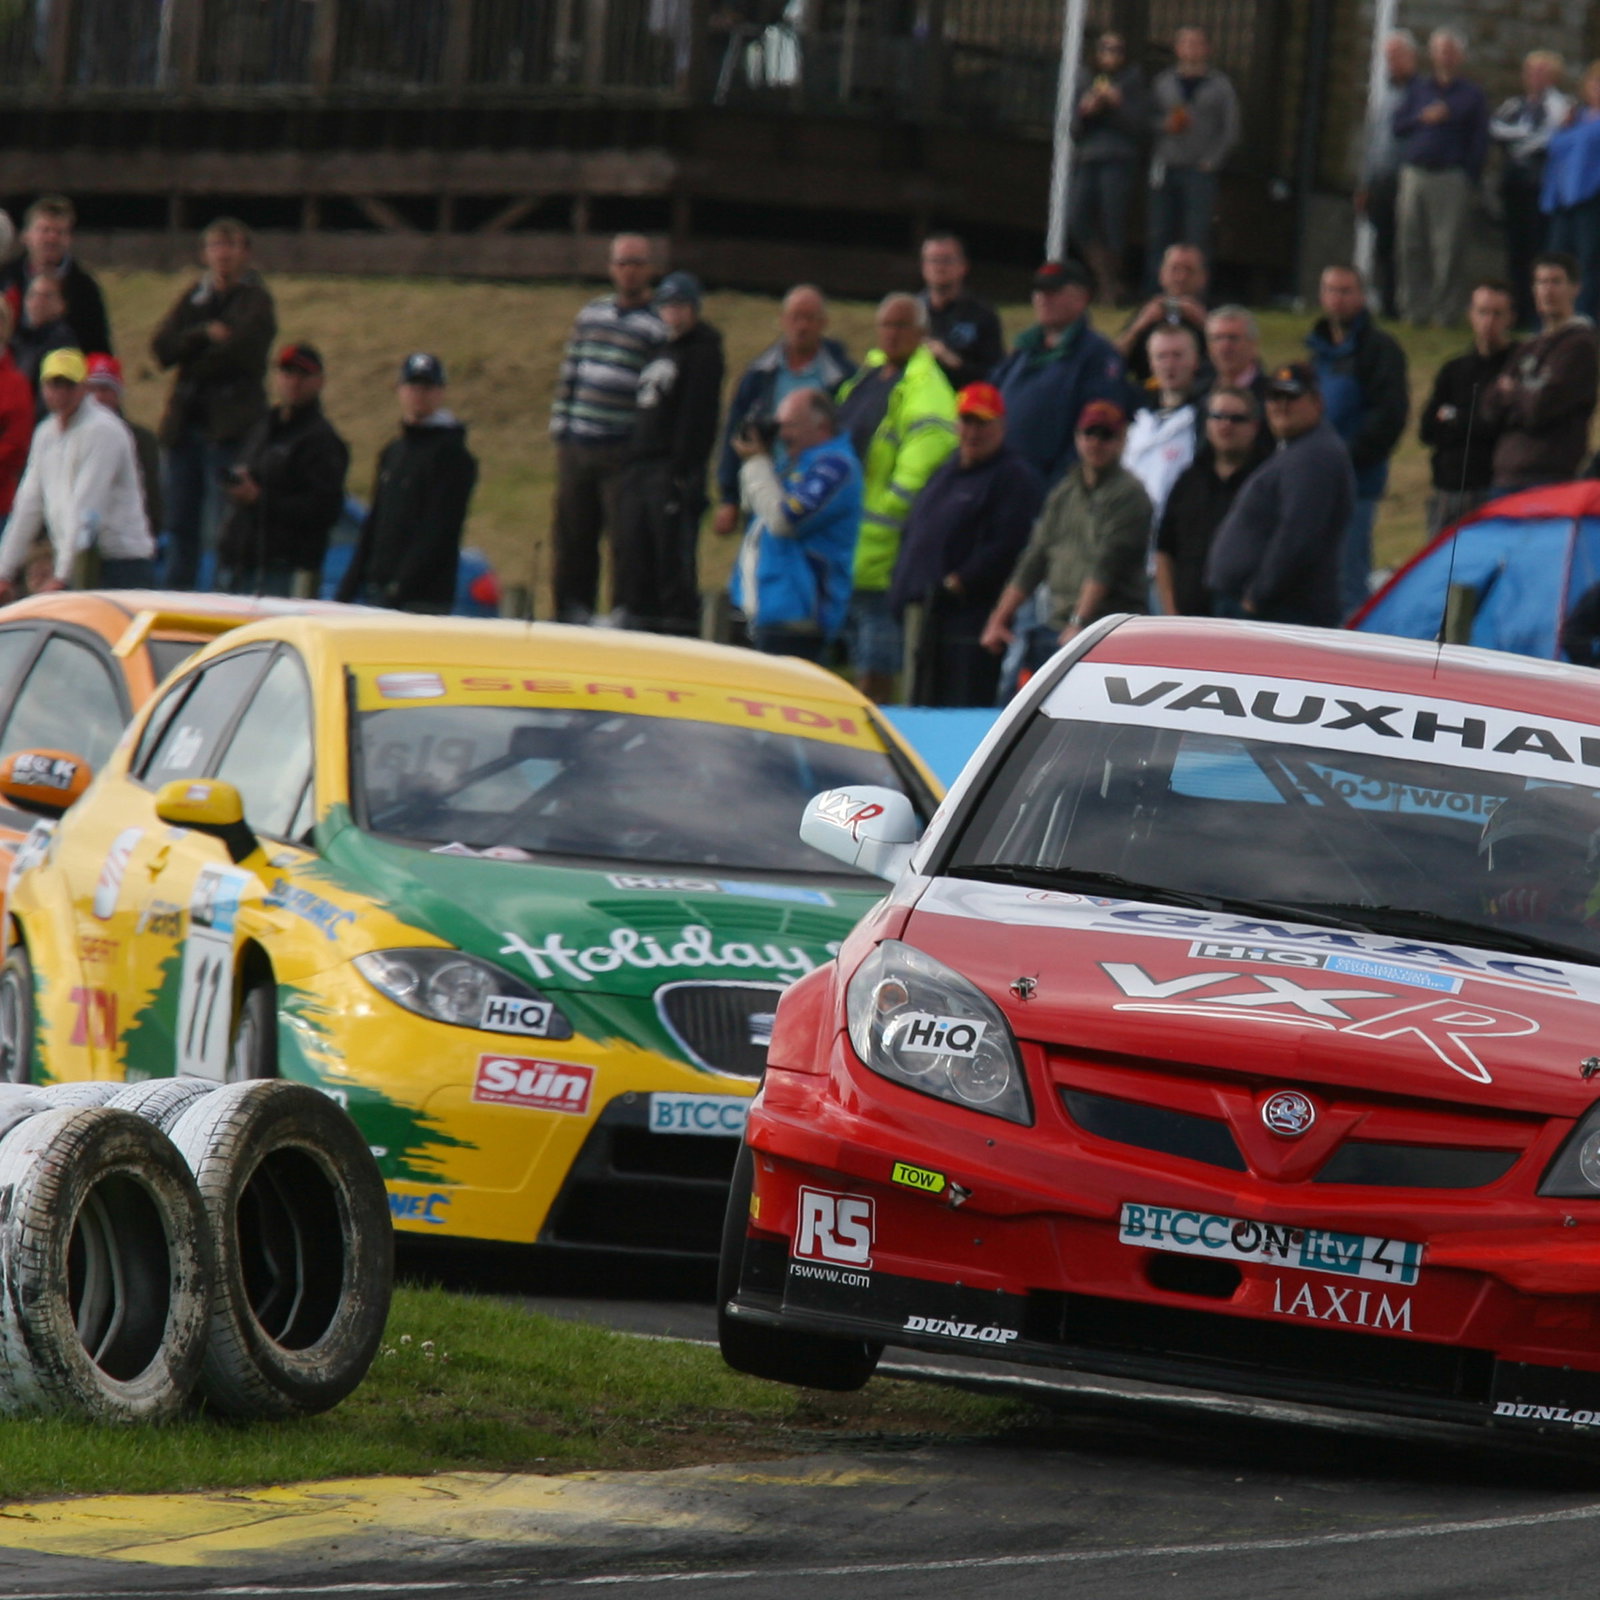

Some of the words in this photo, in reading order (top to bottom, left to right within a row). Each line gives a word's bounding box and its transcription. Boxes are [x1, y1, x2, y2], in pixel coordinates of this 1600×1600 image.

[461, 677, 696, 702] SEAT
[727, 697, 858, 735] TDI
[817, 790, 885, 843] VXR
[500, 924, 816, 983] Holiday
[1110, 910, 1571, 985] GMAC
[1204, 945, 1319, 967] HiQ
[487, 1001, 544, 1028] HiQ
[1098, 961, 1541, 1084] VXR
[907, 1019, 977, 1052] HiQ
[478, 1060, 587, 1101] Sun
[655, 1101, 745, 1130] BTCC
[899, 1167, 936, 1187] TOW
[799, 1192, 870, 1263] RS
[1124, 1205, 1230, 1248] BTCC
[1306, 1229, 1359, 1266] itv
[790, 1263, 871, 1288] rswww.com
[903, 1315, 1018, 1344] DUNLOP
